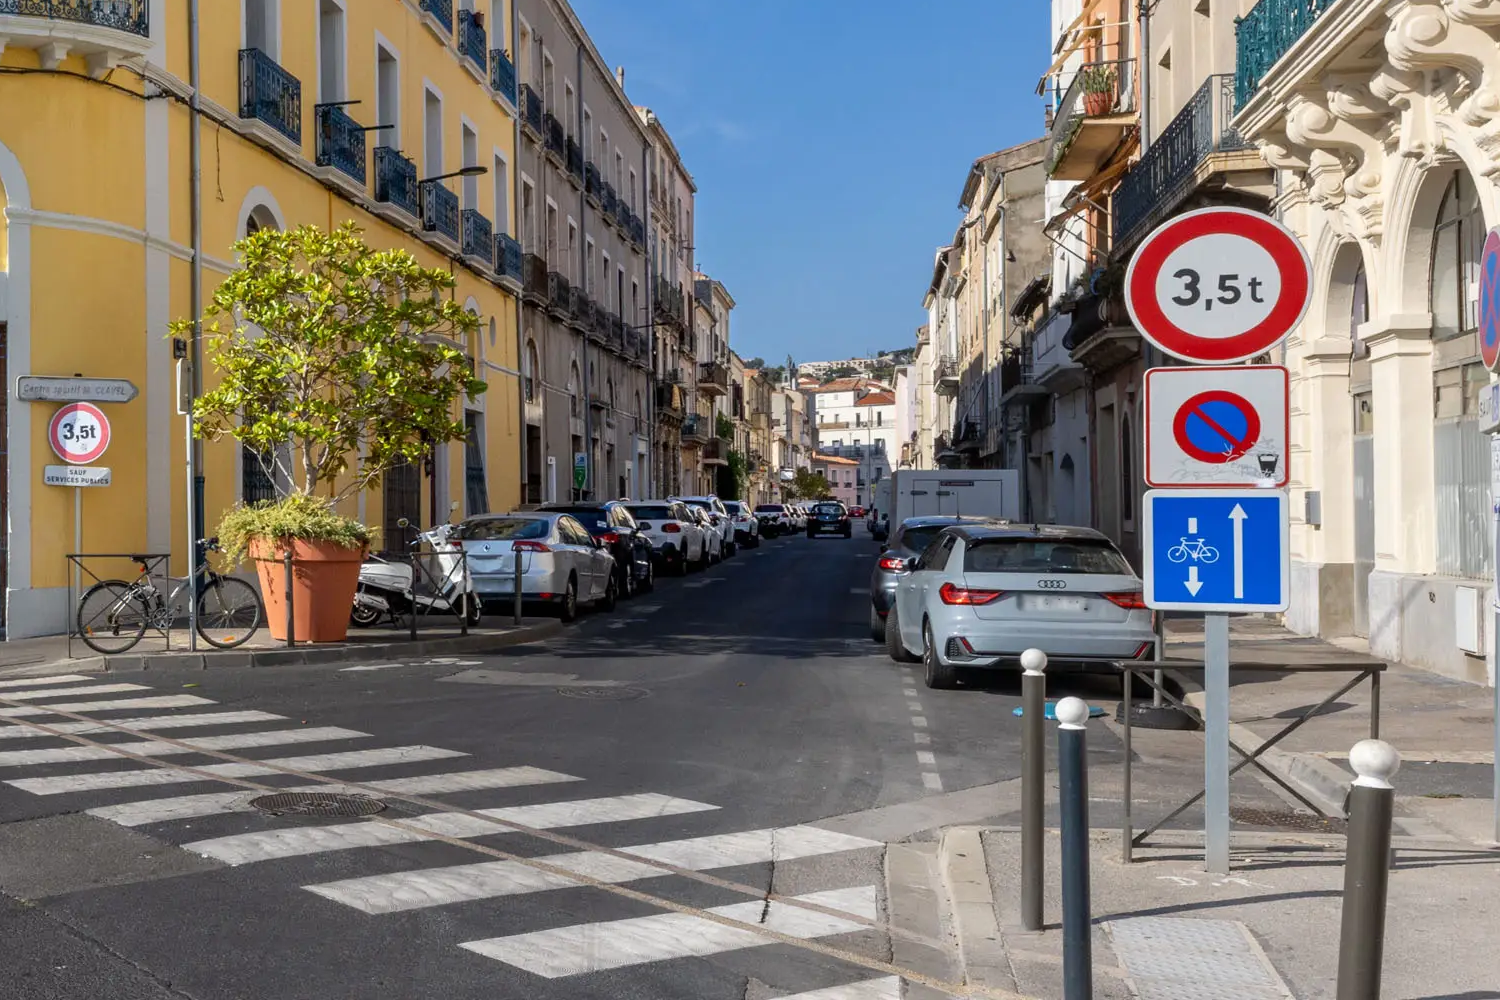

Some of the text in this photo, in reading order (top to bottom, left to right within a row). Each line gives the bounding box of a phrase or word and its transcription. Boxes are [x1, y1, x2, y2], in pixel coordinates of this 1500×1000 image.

[62, 422, 97, 442] 3,5t
[46, 475, 109, 485] SERVICES PUBLICS
